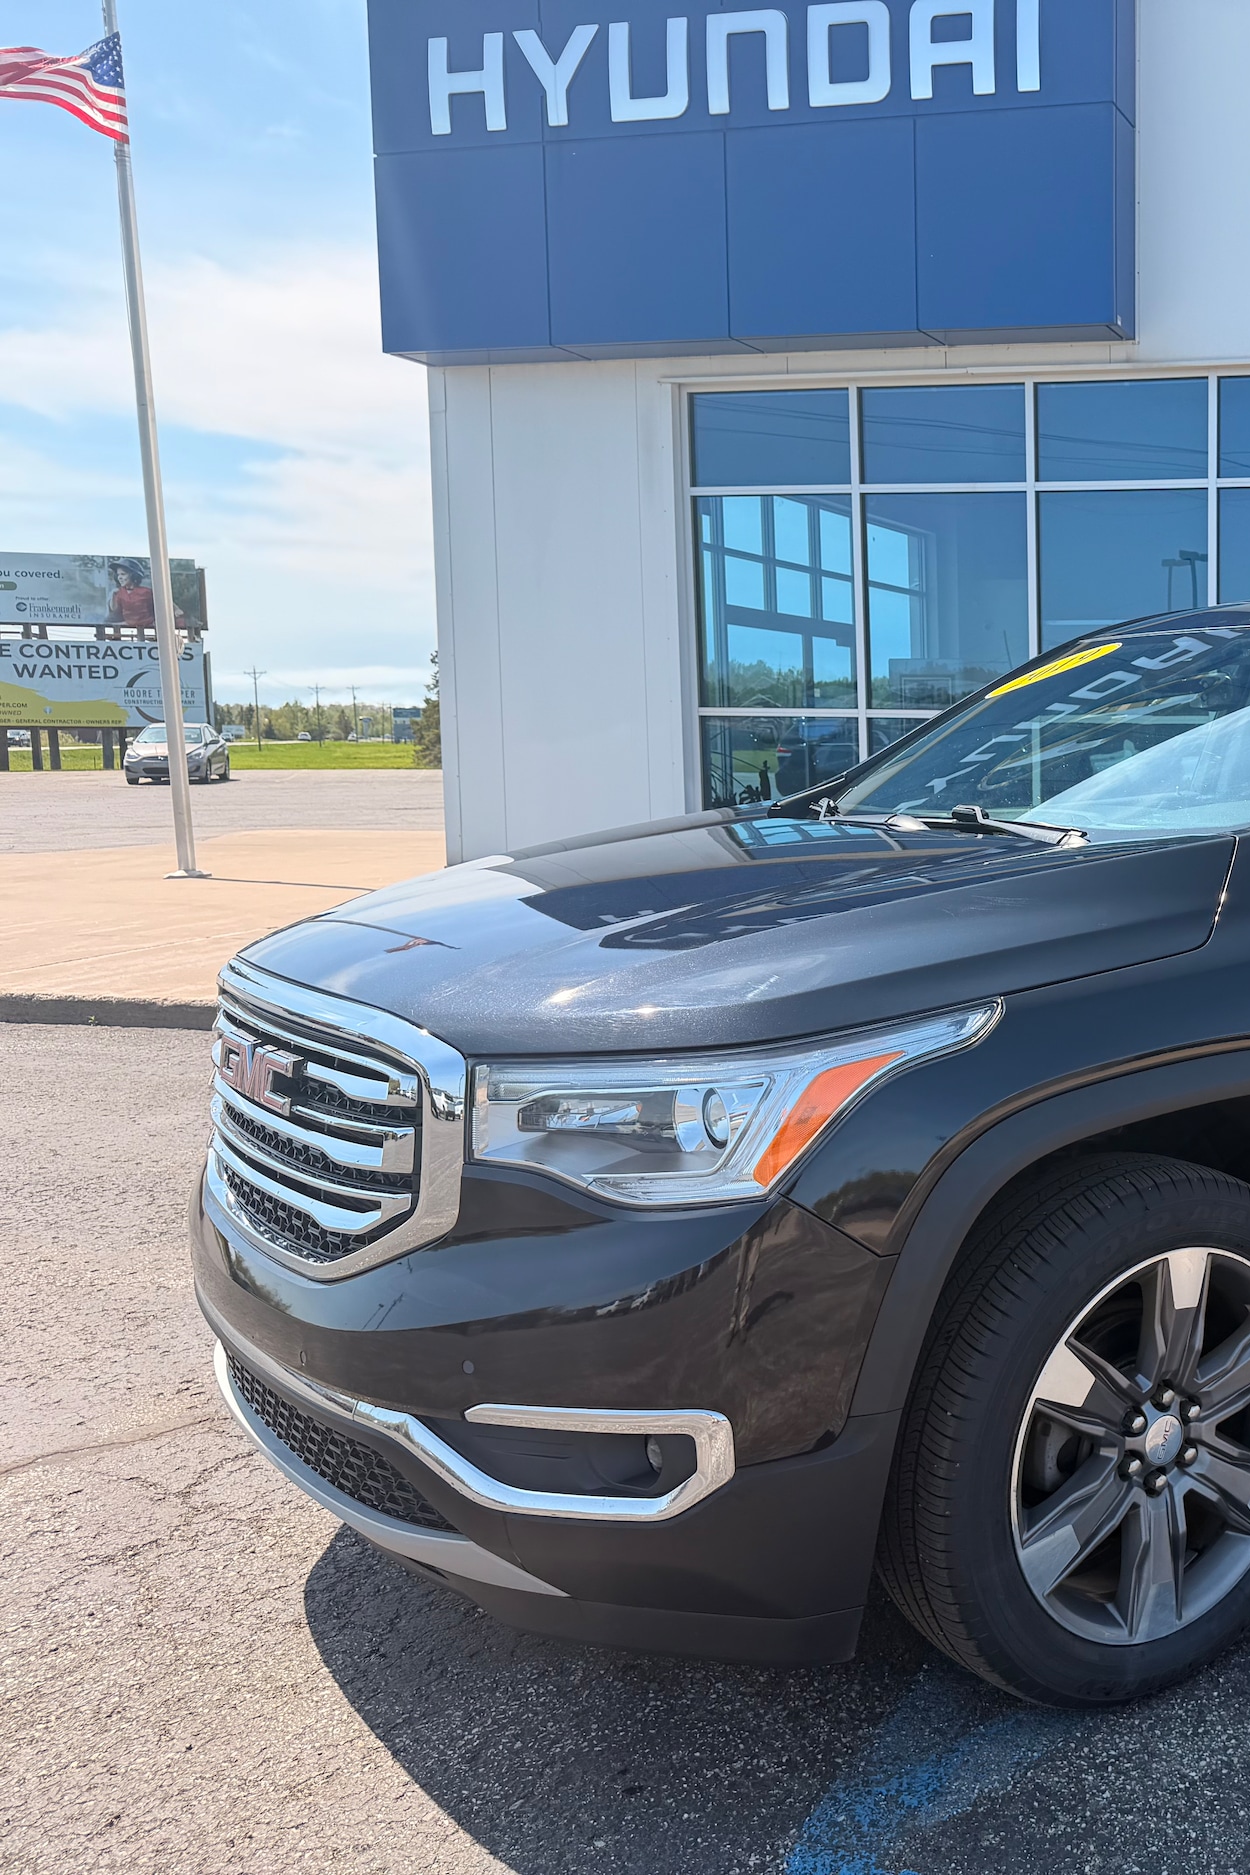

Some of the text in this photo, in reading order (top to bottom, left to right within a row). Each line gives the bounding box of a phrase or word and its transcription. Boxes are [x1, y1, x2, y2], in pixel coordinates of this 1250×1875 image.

[427, 0, 1042, 135] HYUNDAI
[15, 569, 64, 579] covered.
[29, 602, 81, 614] Frankenmuth
[19, 643, 194, 661] CONTRACTOS
[12, 663, 119, 680] WANTED
[123, 689, 153, 698] MOORE
[220, 1031, 293, 1117] GMC
[1156, 1419, 1173, 1460] GMC
